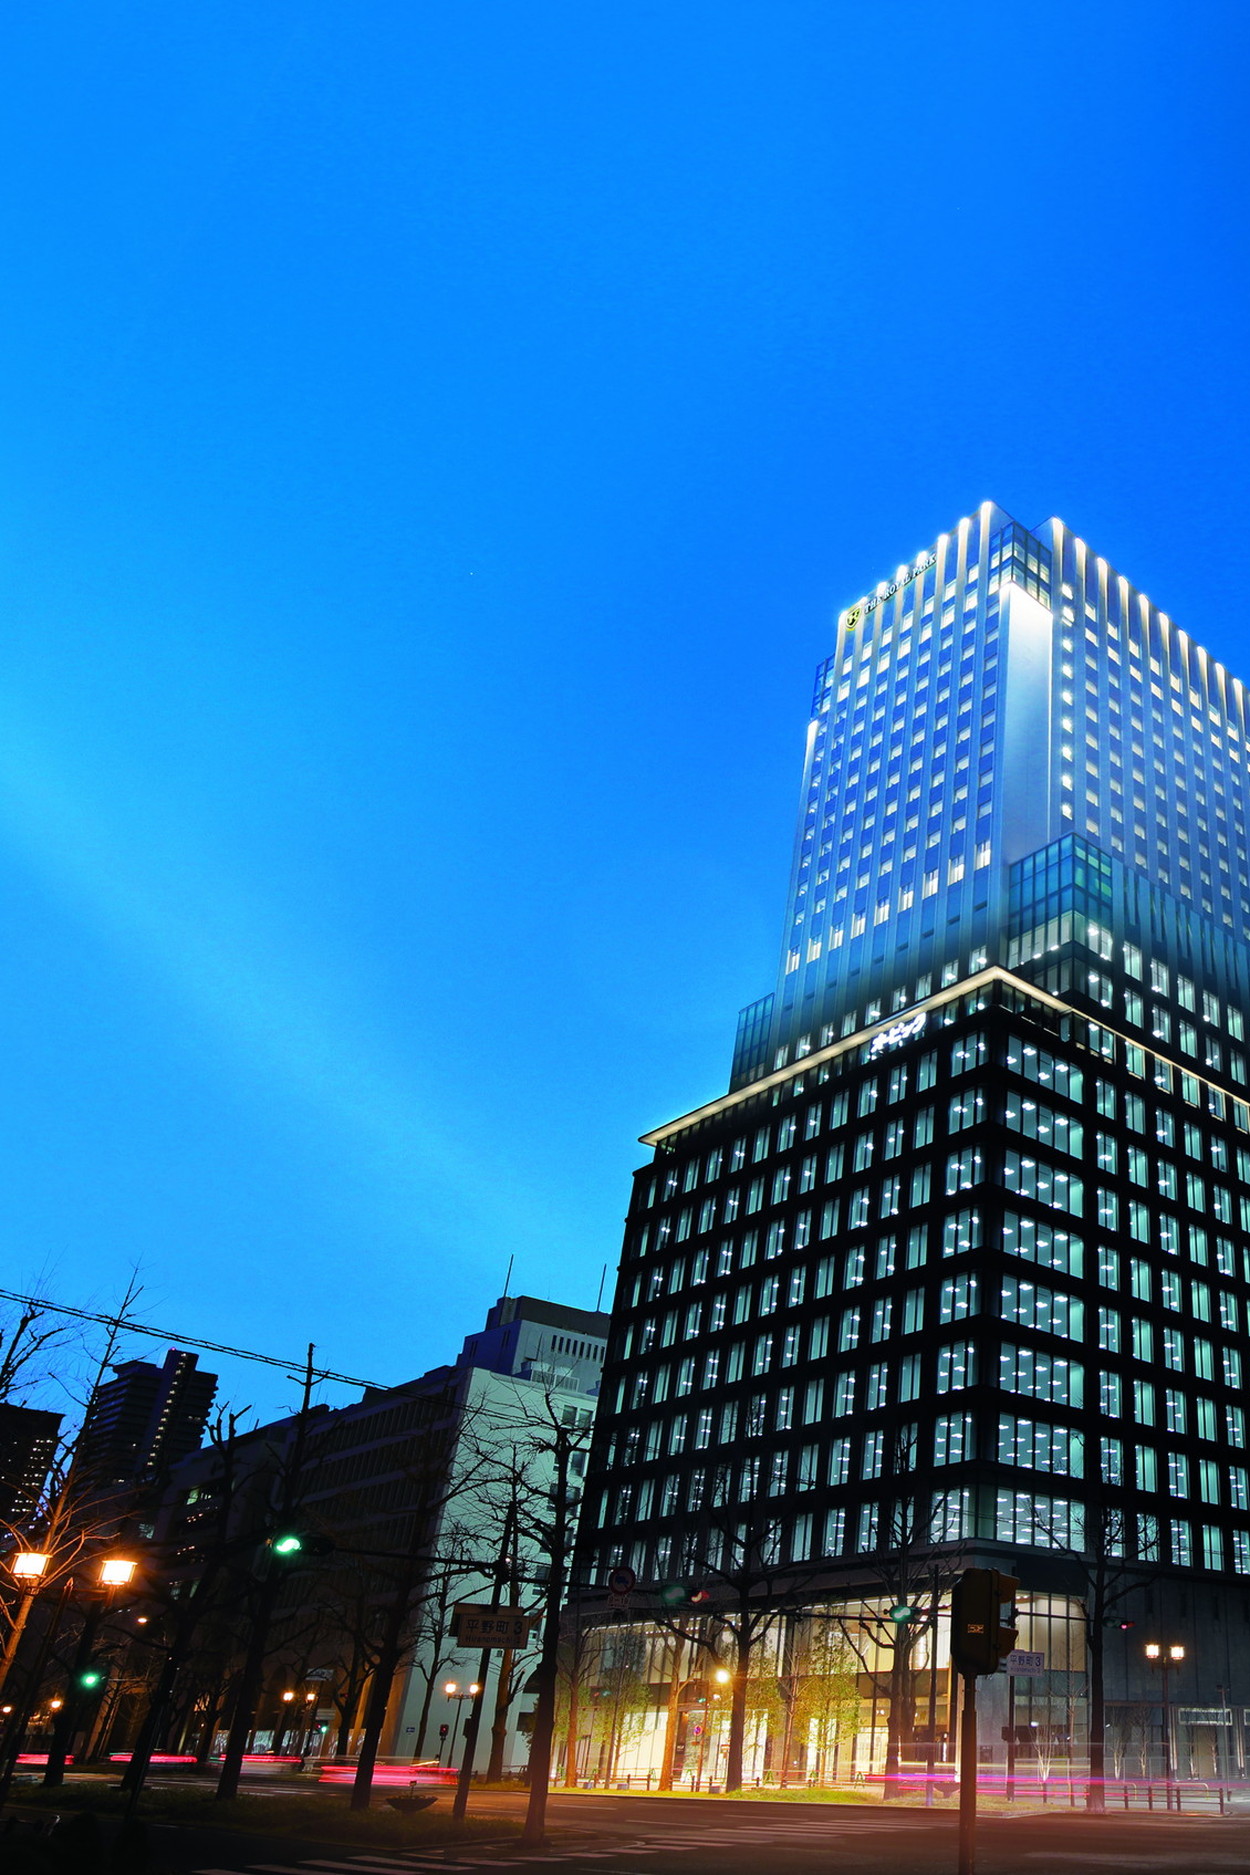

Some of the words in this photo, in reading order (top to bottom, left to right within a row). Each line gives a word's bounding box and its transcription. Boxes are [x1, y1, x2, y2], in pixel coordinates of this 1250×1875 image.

[884, 573, 911, 600] ROYAL
[912, 554, 937, 578] PARK
[466, 1619, 509, 1634] 平野町
[514, 1621, 523, 1635] 3
[1010, 1655, 1033, 1666] 平野町
